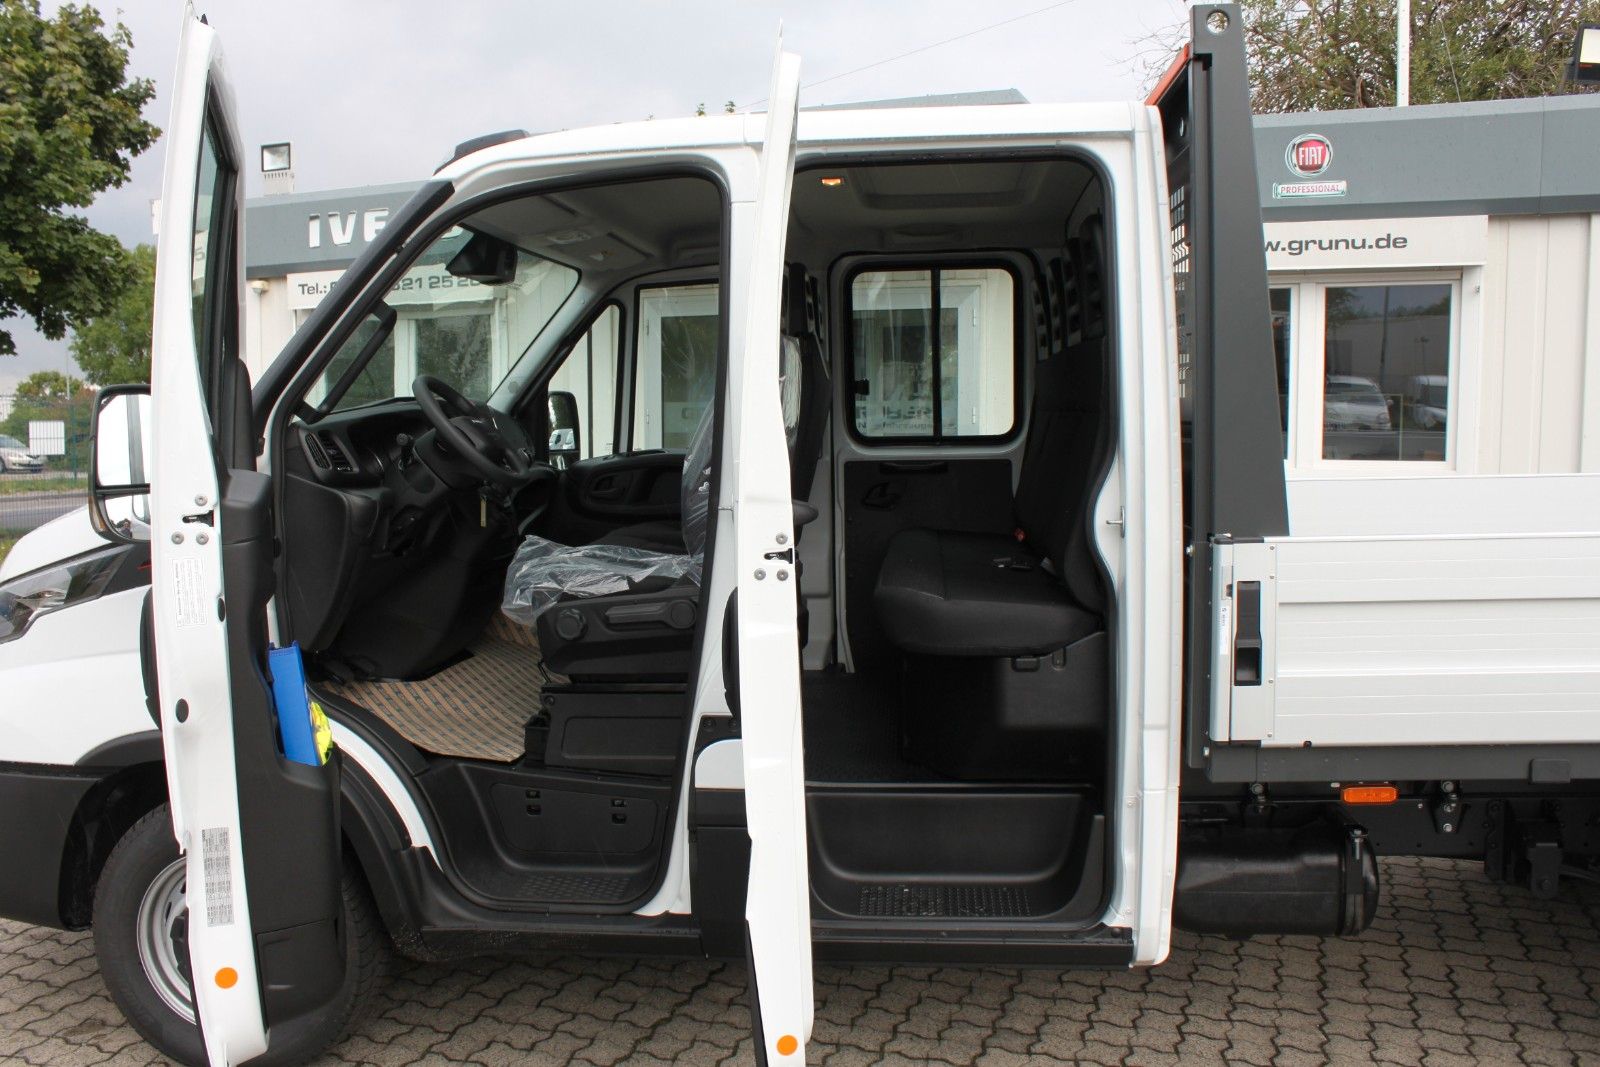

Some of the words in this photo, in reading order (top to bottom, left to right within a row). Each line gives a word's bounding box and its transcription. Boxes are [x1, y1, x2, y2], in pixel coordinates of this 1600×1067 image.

[1298, 146, 1324, 166] FIAT
[1280, 184, 1341, 194] PROFESSIONAL
[1264, 233, 1408, 256] w.grunu.de
[298, 282, 327, 295] Tel.:
[428, 275, 454, 289] 25
